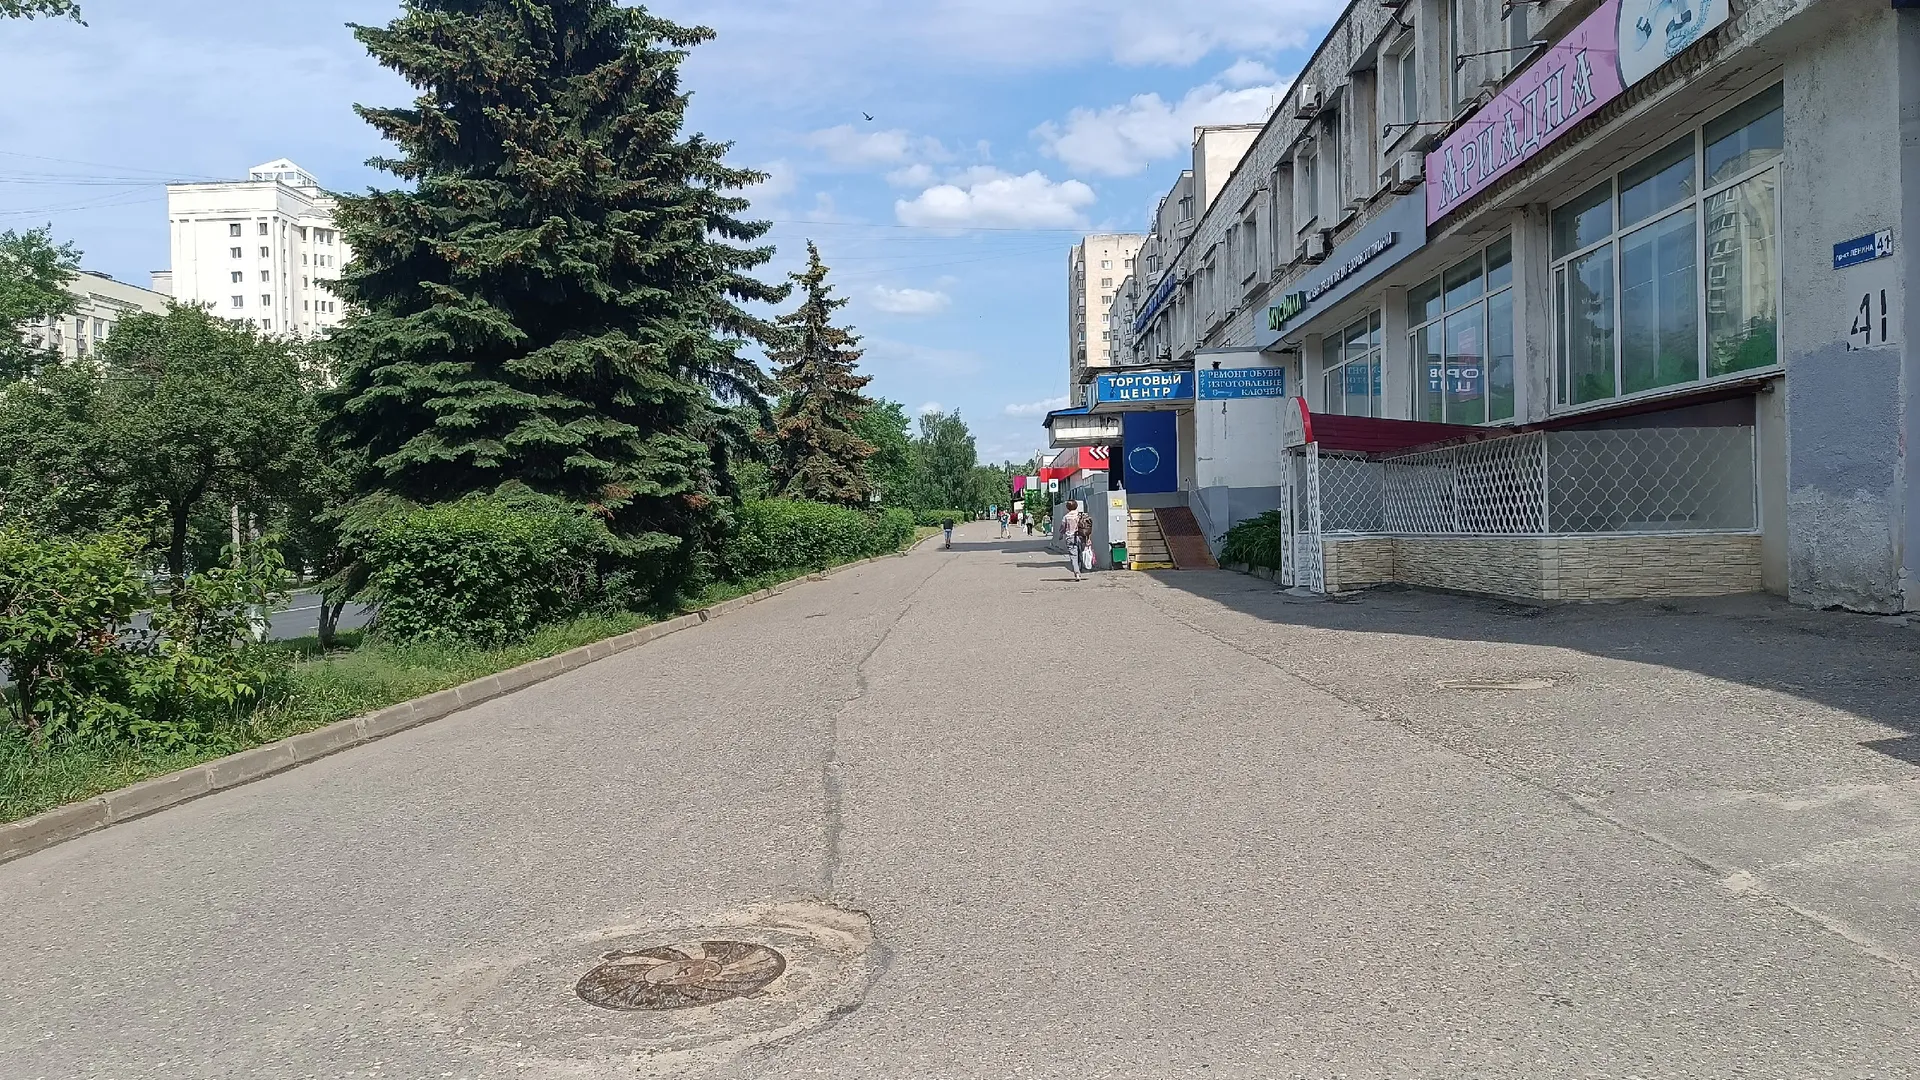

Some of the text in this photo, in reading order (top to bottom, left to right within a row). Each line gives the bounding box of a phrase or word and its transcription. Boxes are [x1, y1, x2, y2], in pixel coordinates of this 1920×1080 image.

[1438, 47, 1597, 211] АРИАДНА
[1850, 244, 1874, 258] ЛЕНИНА
[1877, 235, 1892, 251] 41
[1851, 289, 1886, 345] 41
[1108, 373, 1182, 388] ТОРГОВЫЙ
[1208, 369, 1281, 379] РЕМОНТ ОБУВИ
[1208, 379, 1283, 388] ИЗГОТОВЛЕНИЕ
[1120, 387, 1171, 400] ЦЕНТР
[1241, 387, 1283, 396] КЛЮЧЕЙ
